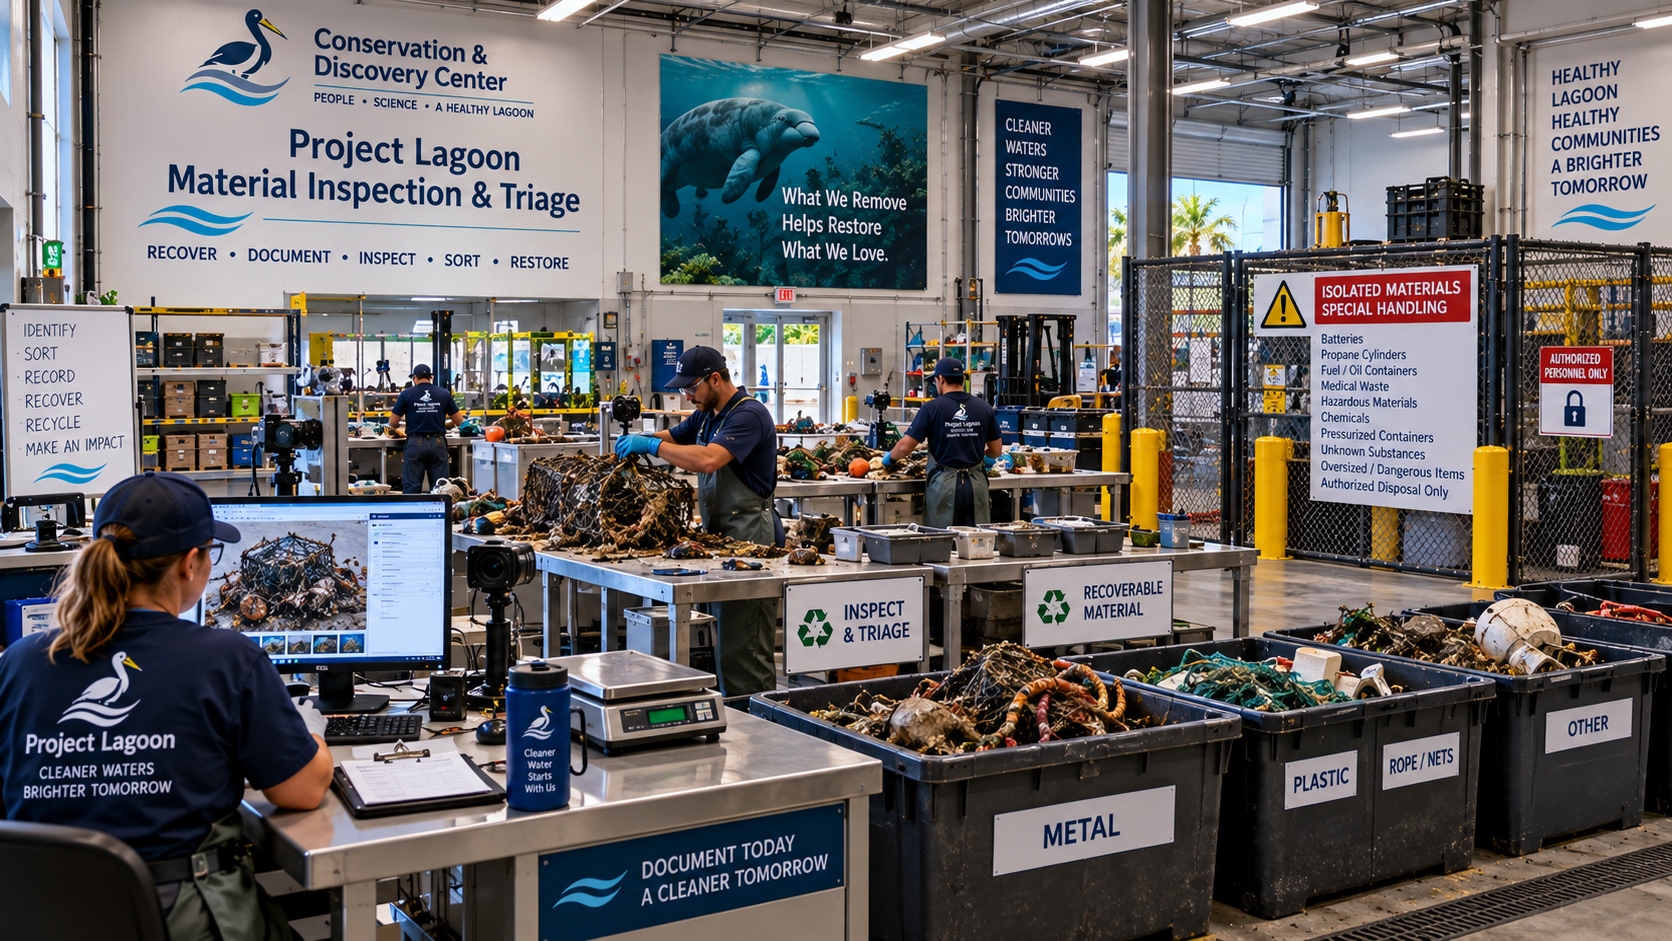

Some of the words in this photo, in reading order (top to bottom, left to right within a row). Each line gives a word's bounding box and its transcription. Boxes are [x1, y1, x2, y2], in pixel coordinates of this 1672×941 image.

[314, 28, 465, 62] Conservation
[472, 44, 487, 65] &
[315, 55, 428, 90] Discovery
[434, 66, 507, 91] Center
[1552, 60, 1621, 85] HEALTHY
[1552, 84, 1617, 107] LAGOON
[314, 92, 354, 105] PEOPLE
[374, 97, 417, 110] SCIENCE
[435, 102, 443, 112] A
[446, 103, 490, 115] HEALTHY
[493, 106, 534, 118] LAGOON
[1006, 118, 1051, 136] CLEANER
[1552, 106, 1620, 130] HEALTHY
[1551, 125, 1660, 151] COMMUNITIES
[290, 128, 404, 169] Project
[416, 137, 520, 175] Lagoon
[1005, 139, 1047, 157] WATERS
[1006, 163, 1059, 180] STRONGER
[1551, 159, 1561, 174] A
[1567, 151, 1642, 172] BRIGHTER
[168, 164, 297, 199] Material
[309, 172, 461, 209] Inspection
[472, 181, 492, 208] &
[500, 182, 580, 219] Triage
[1551, 173, 1648, 196] TOMORROW
[782, 187, 821, 206] What
[825, 189, 848, 207] We
[853, 191, 907, 211] Remove
[1005, 185, 1076, 203] COMMUNITIES
[783, 213, 823, 237] Helps
[829, 216, 882, 235] Restore
[1006, 208, 1055, 224] BRIGHTER
[1005, 230, 1072, 246] TOMORROWS
[148, 245, 217, 260] RECOVER
[248, 248, 331, 263] DOCUMENT
[360, 251, 416, 265] INSPECT
[445, 254, 481, 267] SORT
[511, 256, 569, 270] RESTORE
[782, 240, 821, 259] What
[825, 242, 848, 260] We
[853, 243, 888, 262] Love.
[1322, 284, 1381, 298] ISOLATED
[1386, 280, 1461, 296] MATERIALS
[1322, 302, 1373, 316] SPECIAL
[1377, 300, 1447, 315] HANDLING
[24, 323, 76, 338] IDENTIFY
[1321, 333, 1363, 344] Batteries
[24, 346, 58, 361] SORT
[1321, 349, 1359, 362] Propane
[1362, 349, 1406, 362] Cylinders
[1550, 353, 1601, 364] AUTHORIZED
[25, 369, 75, 384] RECORD
[1321, 365, 1340, 376] Fuel
[1349, 364, 1362, 375] Oil
[1365, 365, 1417, 376] Containers
[1545, 367, 1586, 379] PERSONNEL
[1588, 368, 1608, 379] ONLY
[1321, 380, 1357, 391] Medical
[1359, 381, 1389, 392] Waste
[25, 392, 83, 409] RECOVER
[1321, 396, 1370, 407] Hazardous
[1373, 397, 1417, 408] Materials
[26, 415, 81, 433] RECYCLE
[1321, 411, 1370, 424] Chemicals
[1321, 428, 1376, 441] Pressurized
[1379, 430, 1434, 443] Containers
[26, 440, 58, 456] MAKE
[64, 439, 79, 453] AN
[85, 435, 124, 451] IMPACT
[1321, 444, 1365, 456] Unknown
[1368, 446, 1425, 460] Substances
[1321, 460, 1367, 474] Oversized
[1377, 463, 1432, 479] Dangerous
[1435, 467, 1465, 480] Items
[1321, 477, 1374, 492] Authorized
[1378, 481, 1421, 496] Disposal
[1424, 484, 1449, 500] Only
[1084, 580, 1163, 600] RECOVERABLE
[845, 600, 905, 620] INSPECT
[1084, 602, 1144, 620] MATERIAL
[843, 627, 854, 643] &
[858, 622, 910, 641] TRIAGE
[1568, 715, 1608, 737] OTHER
[25, 732, 95, 758] Project
[101, 731, 175, 755] Lagoon
[524, 748, 556, 758] Cleaner
[527, 761, 552, 769] Water
[1390, 754, 1417, 775] ROPE
[1428, 748, 1453, 767] NETS
[39, 765, 97, 780] CLEANER
[102, 762, 154, 777] WATERS
[528, 772, 552, 781] Starts
[23, 784, 86, 799] BRIGHTER
[91, 780, 172, 796] TOMORROW
[525, 784, 544, 793] With
[546, 783, 556, 792] Us
[1294, 767, 1349, 794] PLASTIC
[1043, 813, 1120, 849] METAL
[642, 845, 737, 879] DOCUMENT
[741, 834, 795, 860] TODAY
[641, 888, 653, 906] A
[658, 873, 730, 902] CLEANER
[735, 853, 828, 887] TOMORROW
